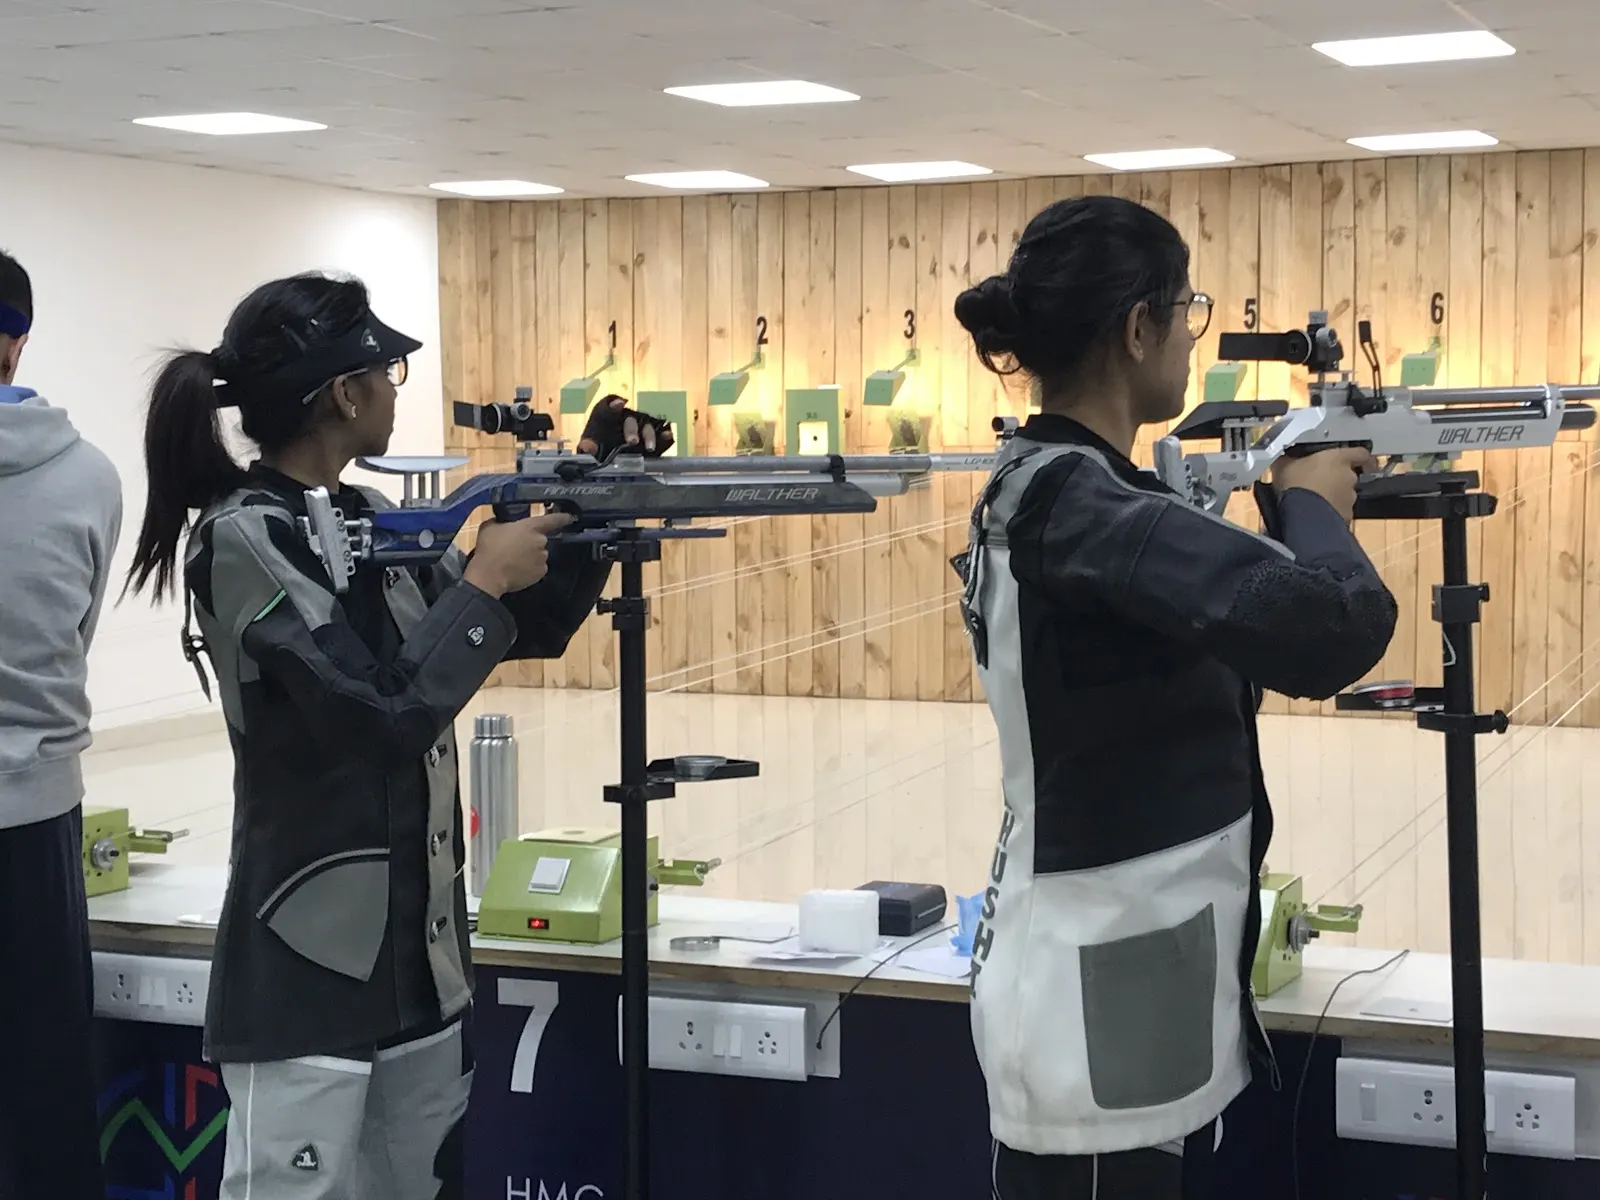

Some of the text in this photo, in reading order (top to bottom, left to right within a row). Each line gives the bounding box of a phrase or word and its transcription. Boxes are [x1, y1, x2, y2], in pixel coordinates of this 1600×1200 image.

[1243, 298, 1257, 329] 5
[1430, 292, 1444, 324] 6
[608, 320, 617, 348] 1
[755, 316, 769, 345] 2
[903, 309, 916, 339] 3
[1437, 424, 1525, 445] WALTHER
[724, 486, 819, 502] WALTHER
[497, 976, 559, 1094] 7
